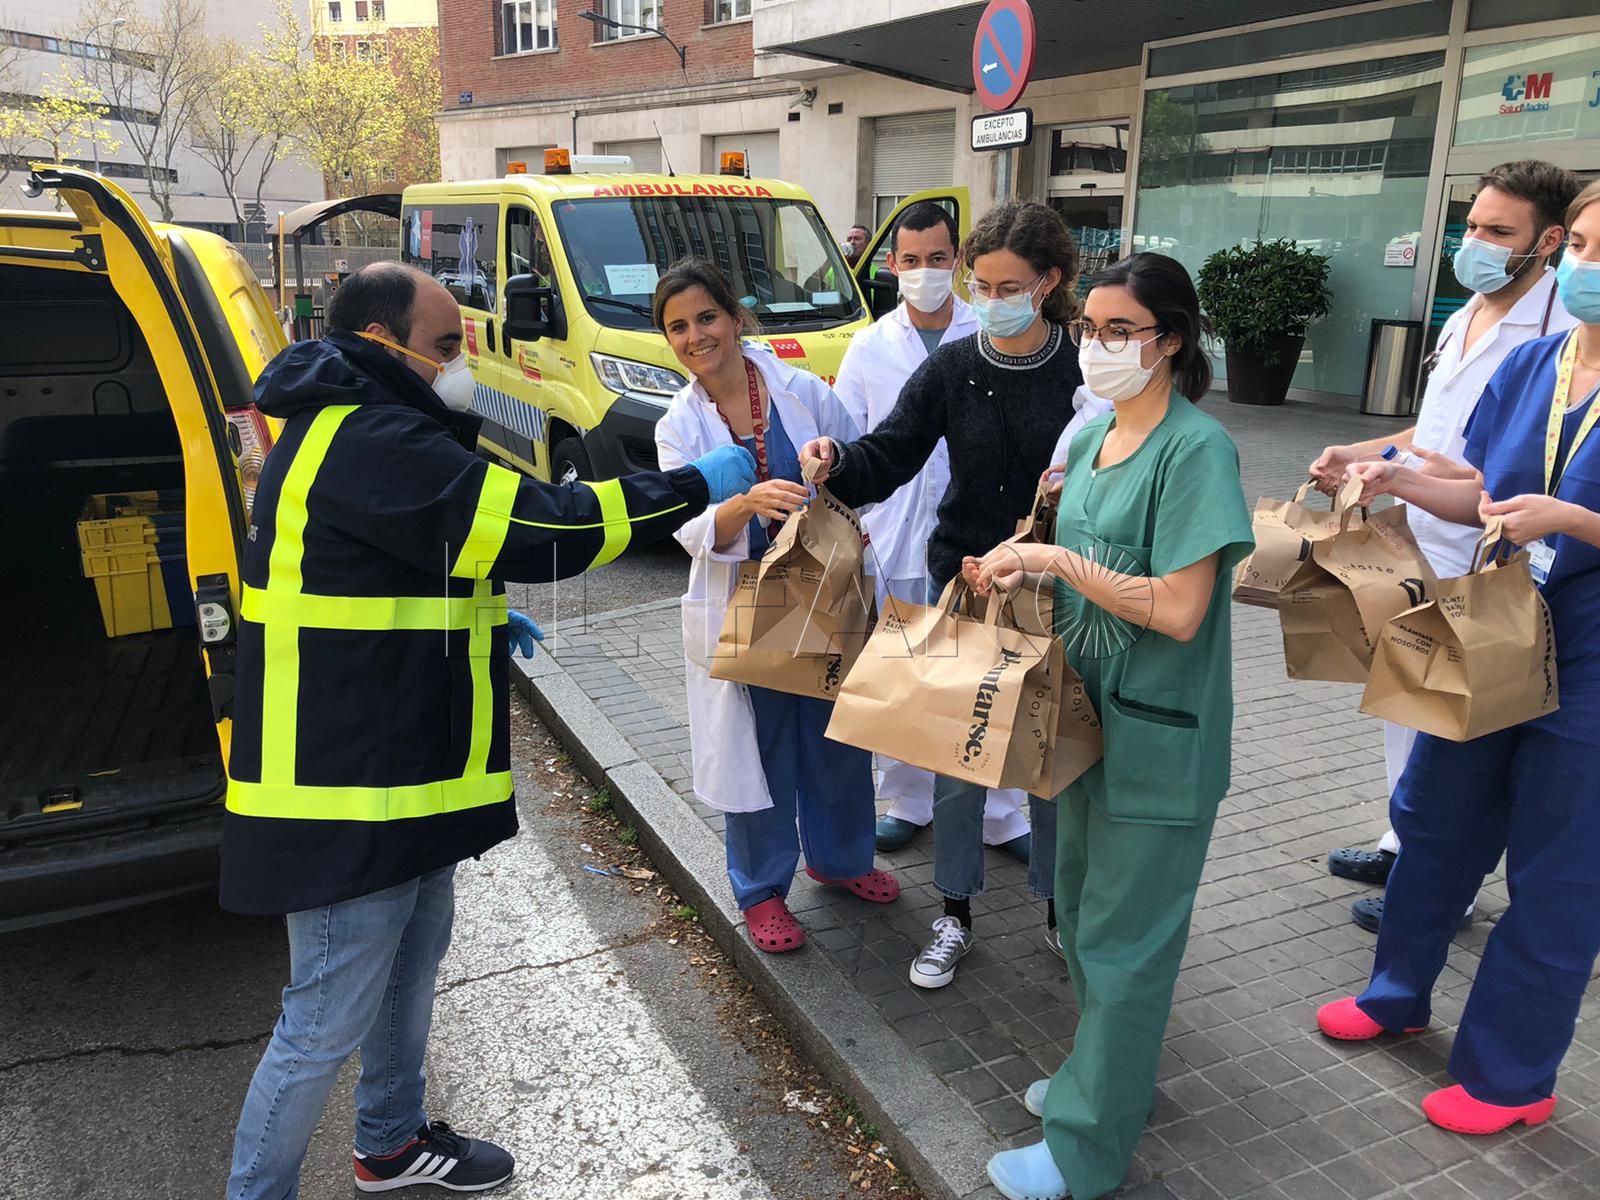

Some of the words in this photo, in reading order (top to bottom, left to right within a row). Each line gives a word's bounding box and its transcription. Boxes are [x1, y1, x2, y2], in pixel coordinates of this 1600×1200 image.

[984, 116, 1014, 130] EXCEPTO
[976, 129, 1022, 144] AMBULANCIAS
[593, 184, 773, 197] AMBULANCIA
[747, 371, 759, 402] YEARS
[1390, 636, 1430, 656] NOSOTROS
[1415, 638, 1432, 649] CON
